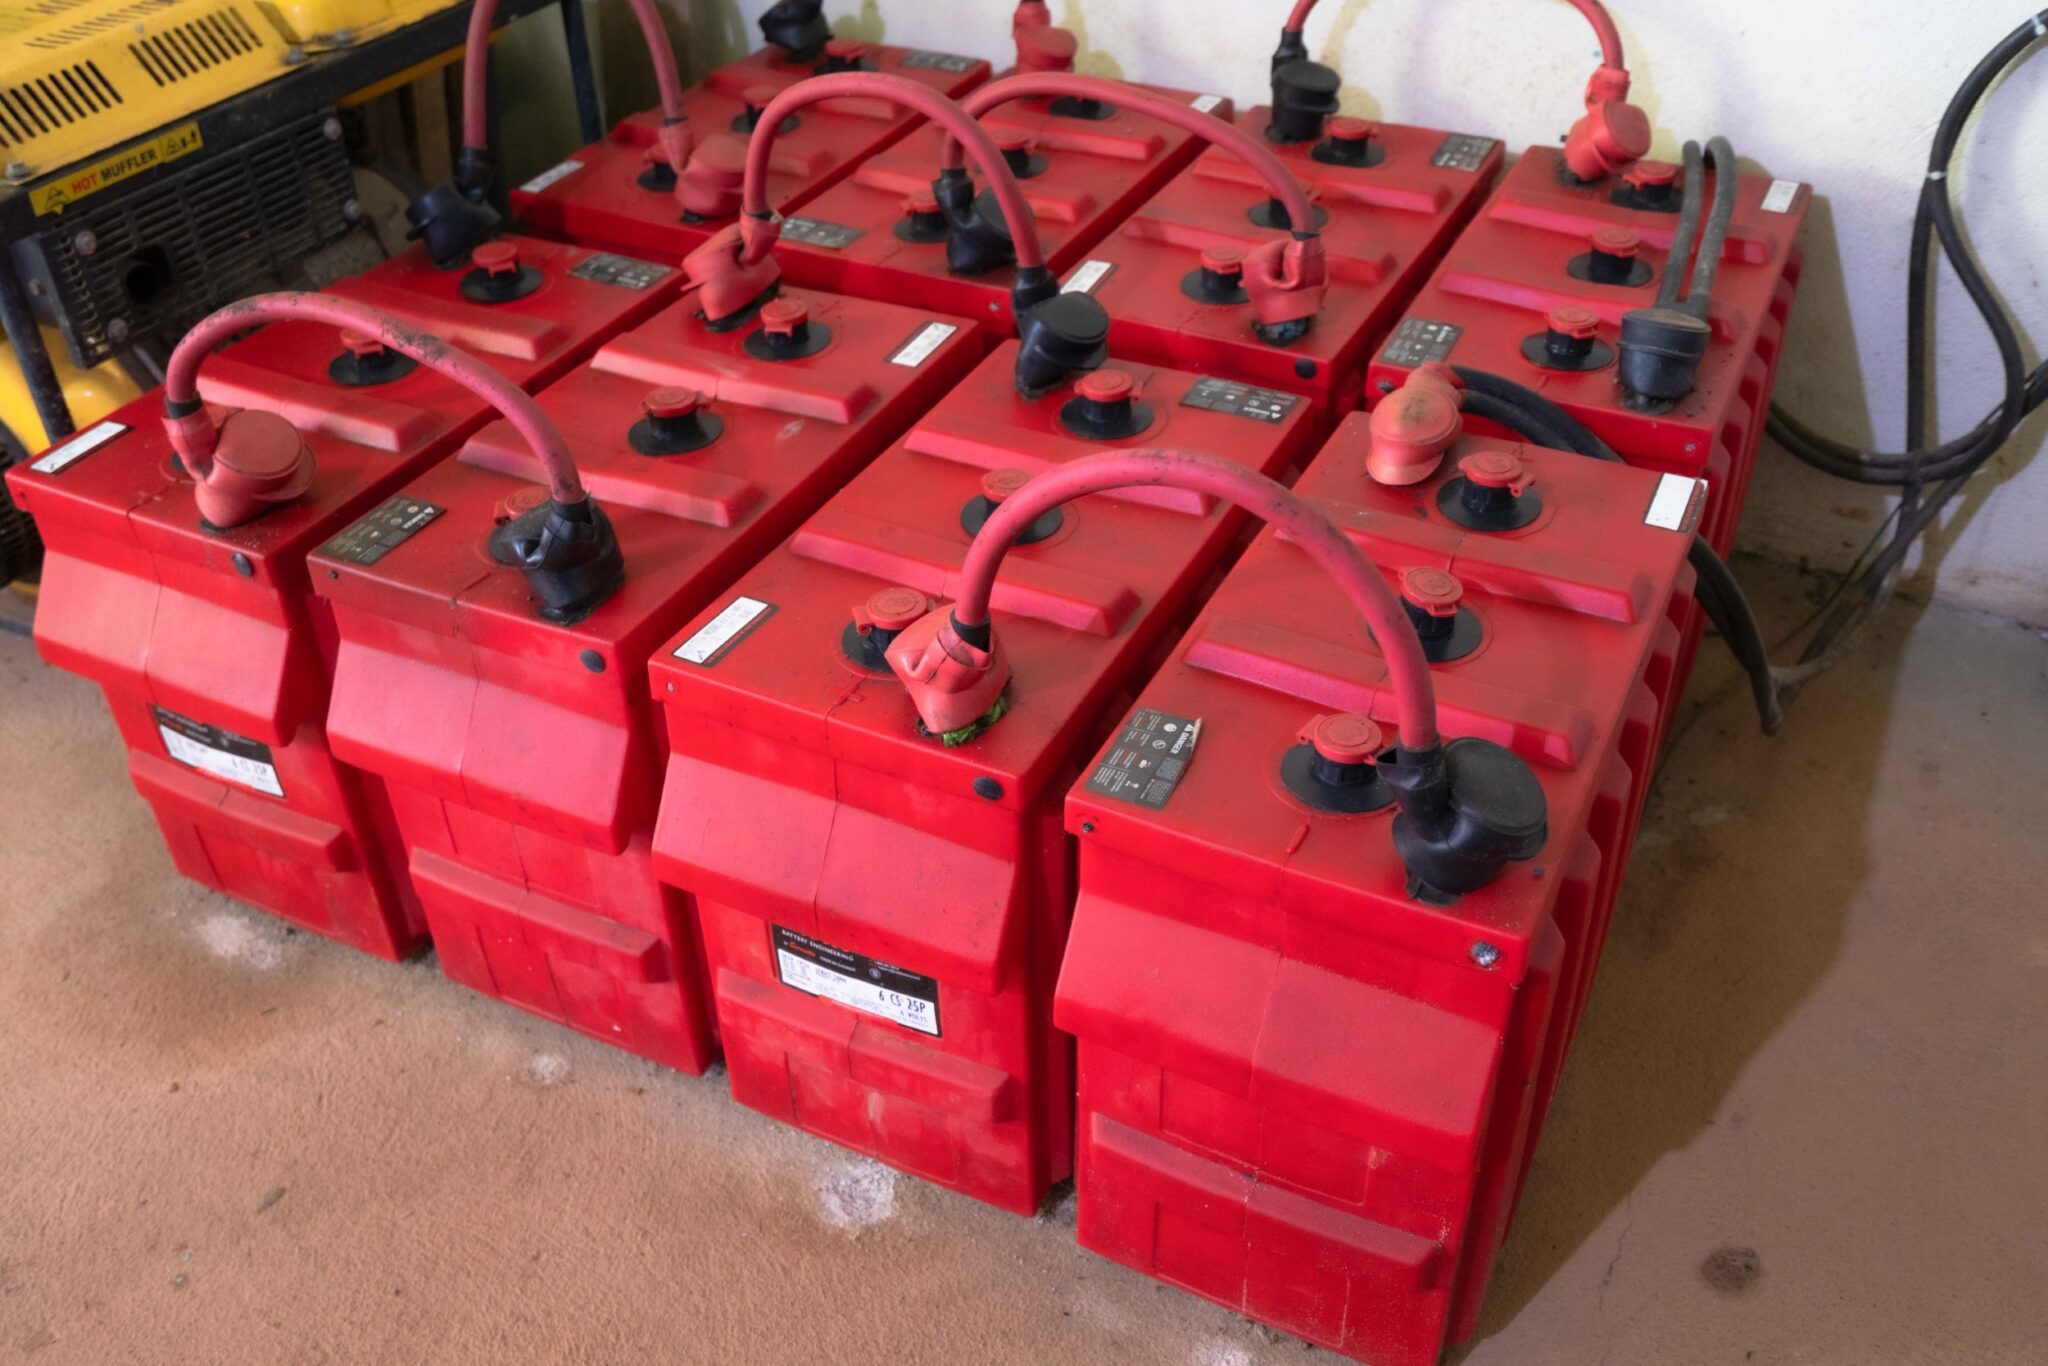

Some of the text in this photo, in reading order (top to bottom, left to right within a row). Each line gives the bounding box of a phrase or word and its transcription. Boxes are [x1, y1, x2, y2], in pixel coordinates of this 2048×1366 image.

[71, 148, 158, 195] HOT MUFFLER
[1170, 732, 1190, 755] DANGER
[781, 928, 854, 961] BATTERY ENGINEERING
[879, 990, 885, 1001] 6
[890, 993, 902, 1007] CS
[907, 998, 926, 1013] 25P
